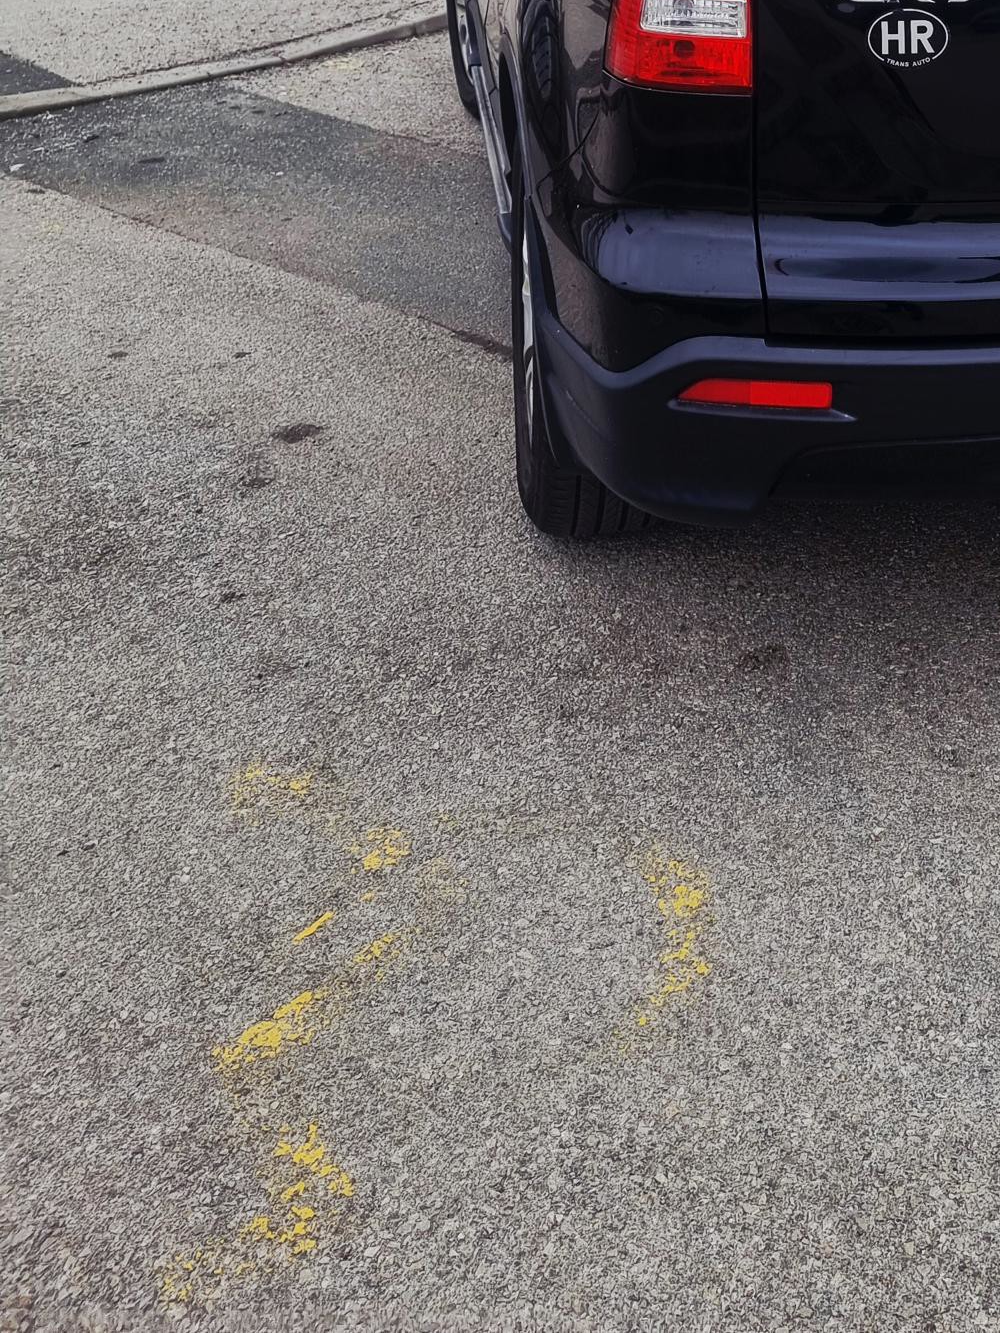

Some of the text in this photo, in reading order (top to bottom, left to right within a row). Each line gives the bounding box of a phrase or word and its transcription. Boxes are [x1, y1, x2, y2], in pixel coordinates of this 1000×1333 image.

[880, 19, 935, 55] HR
[886, 57, 931, 67] TRANS AUTO
